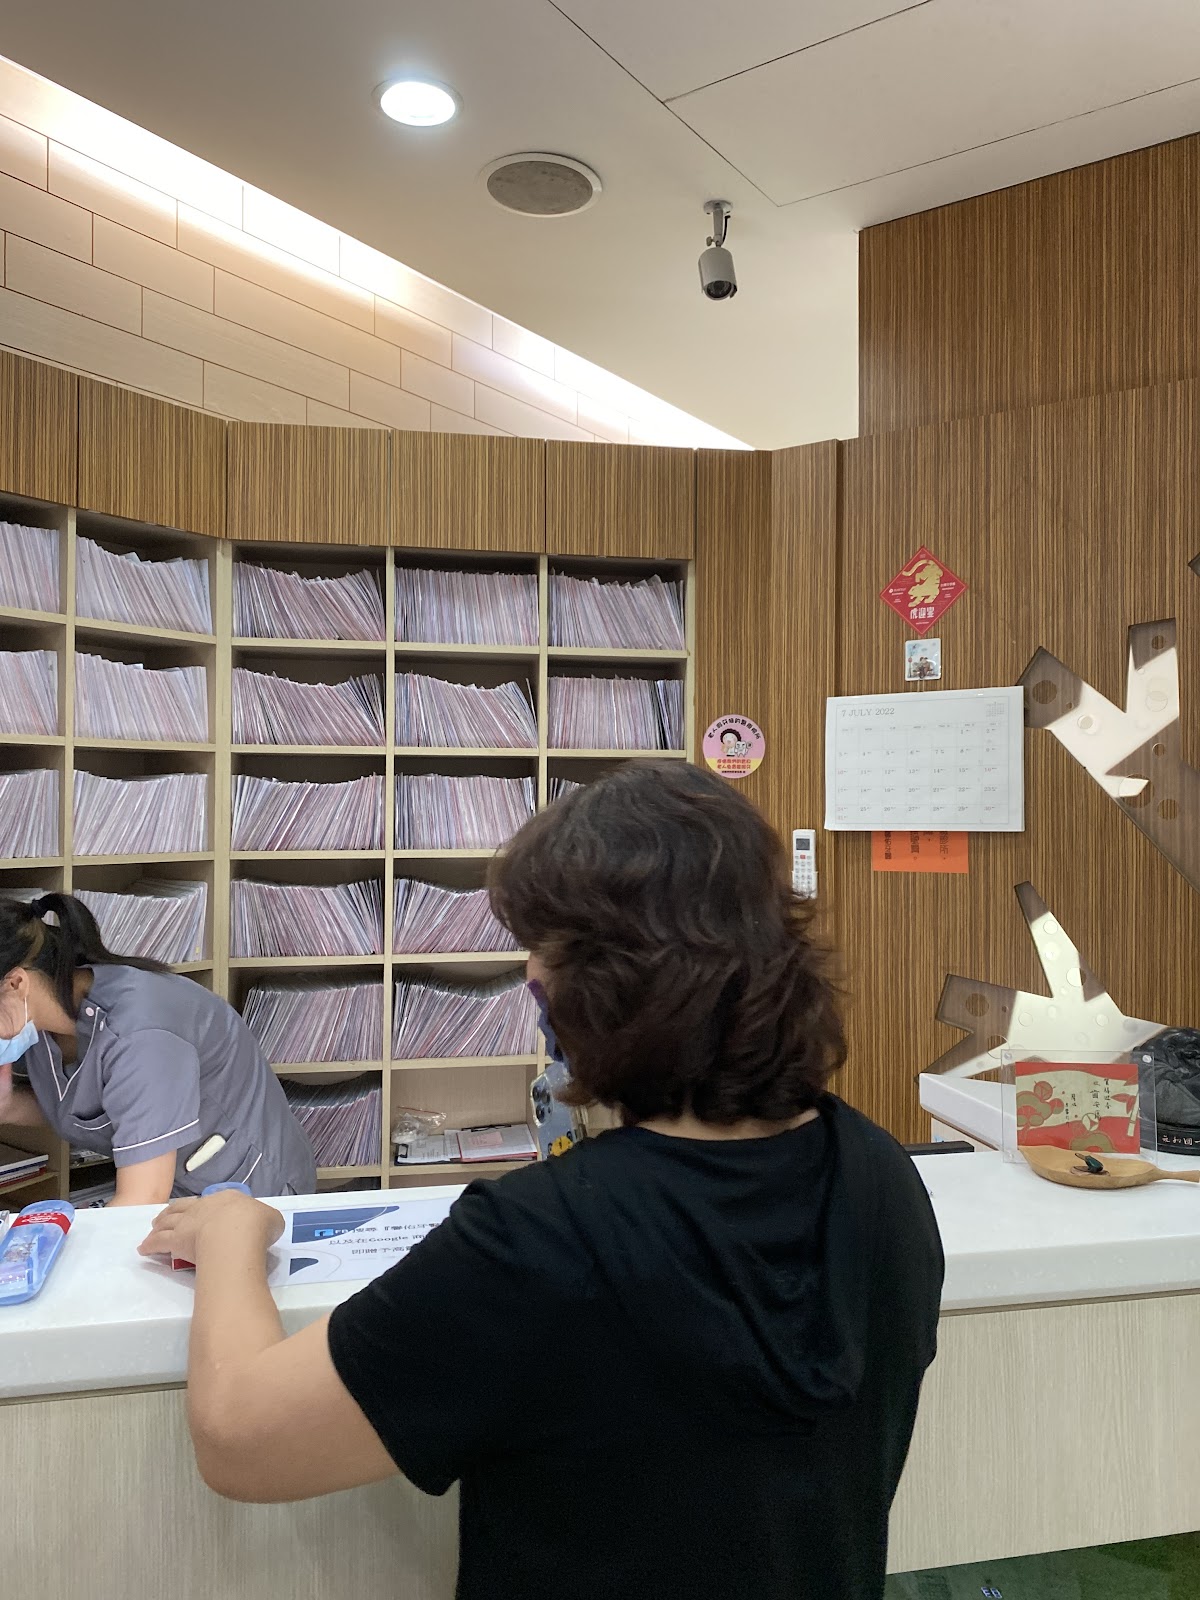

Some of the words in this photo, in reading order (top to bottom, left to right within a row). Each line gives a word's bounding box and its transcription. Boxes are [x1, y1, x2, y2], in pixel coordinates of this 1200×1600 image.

[842, 709, 846, 717] 7
[848, 709, 872, 717] JULY
[875, 707, 895, 716] 2022
